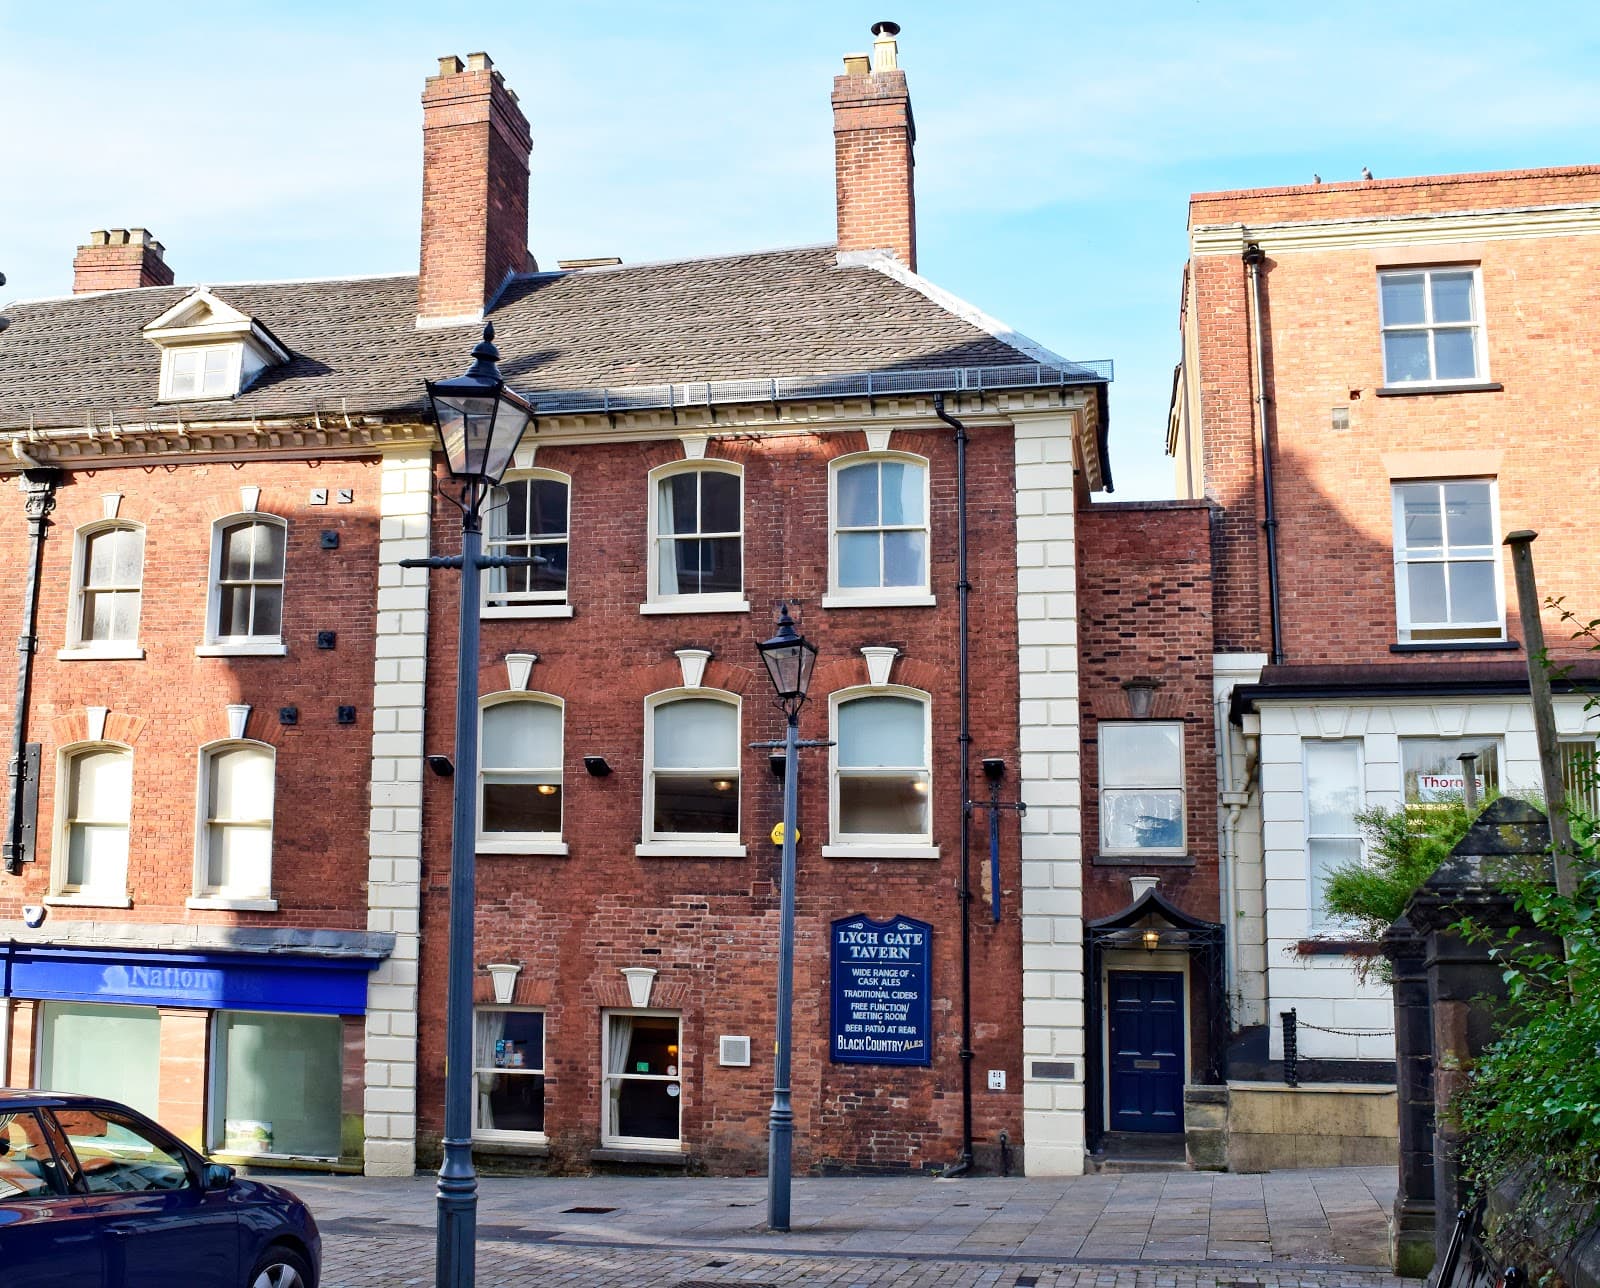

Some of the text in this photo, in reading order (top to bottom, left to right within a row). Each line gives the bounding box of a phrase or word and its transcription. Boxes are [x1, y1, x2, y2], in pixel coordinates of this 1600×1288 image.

[1422, 777, 1481, 788] Thorns
[839, 932, 922, 945] LYCH GATE
[850, 946, 910, 959] TAVERN
[852, 969, 871, 977] WIDE
[873, 969, 898, 977] RANGE
[881, 978, 901, 986] ALES
[844, 990, 918, 1000] TRADITIONAL CIDERS
[851, 1003, 868, 1011] FREE
[853, 1012, 906, 1021] MEETING ROOM
[845, 1024, 863, 1032] BEER
[865, 1025, 885, 1033] PATIO
[898, 1026, 916, 1034] REAR
